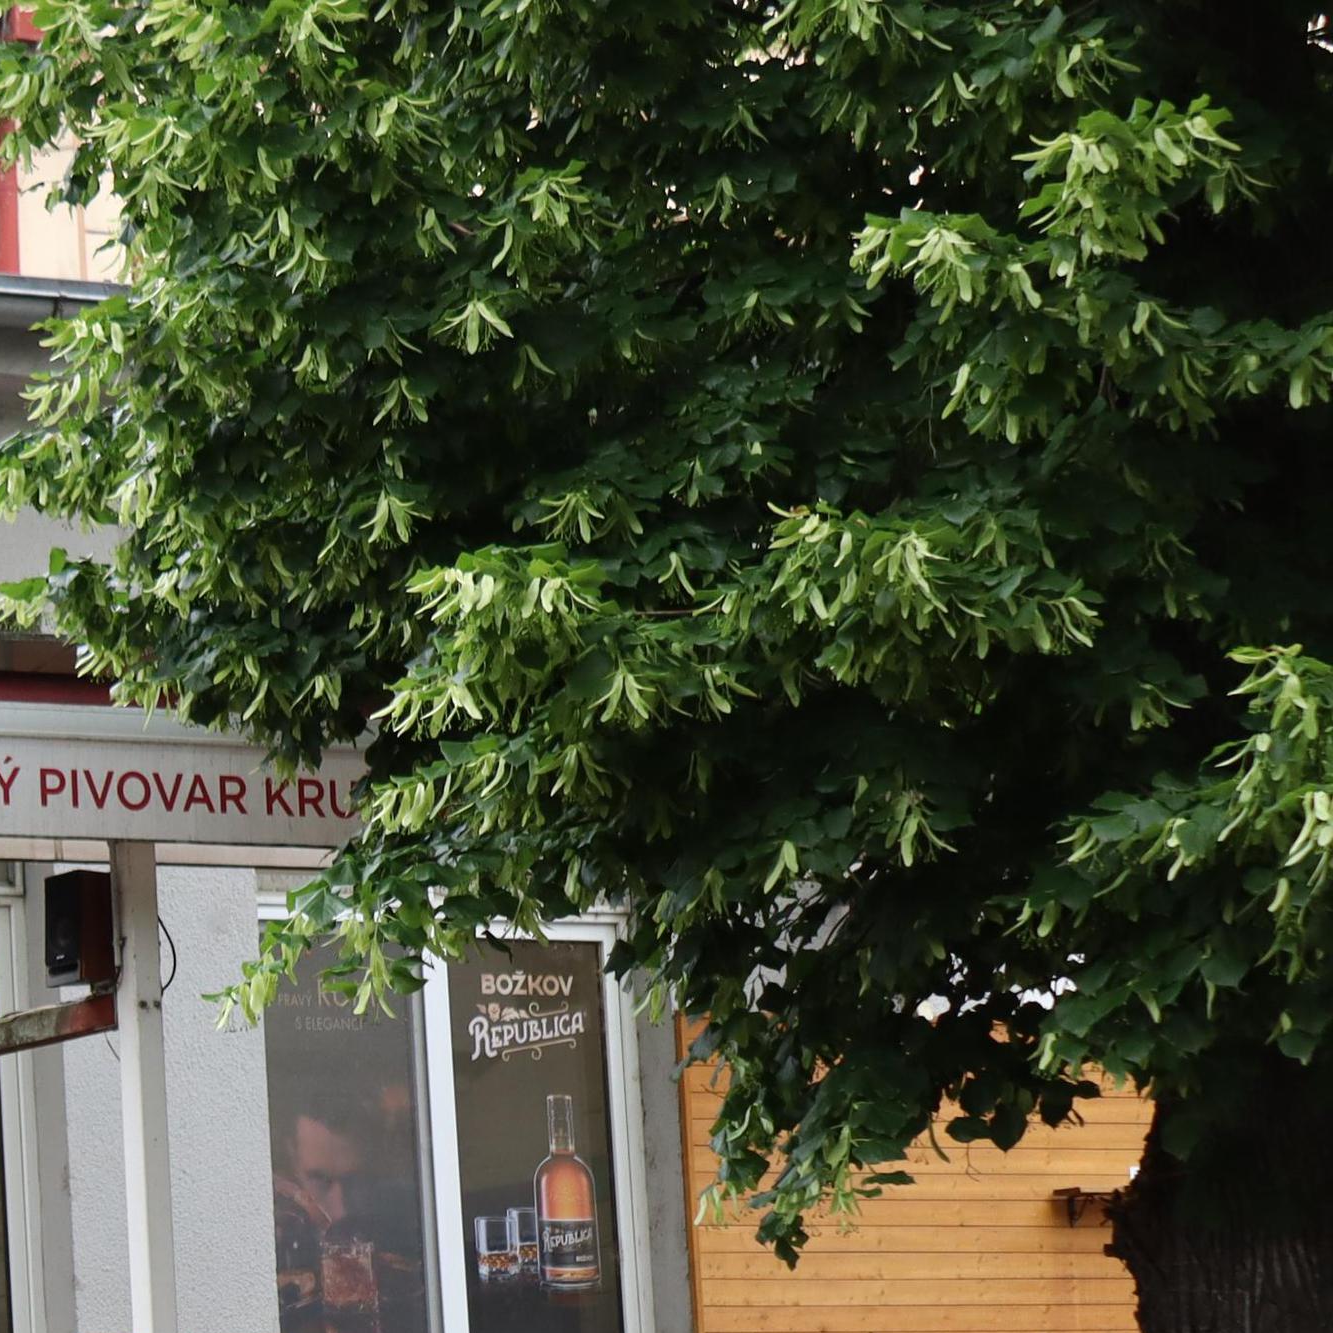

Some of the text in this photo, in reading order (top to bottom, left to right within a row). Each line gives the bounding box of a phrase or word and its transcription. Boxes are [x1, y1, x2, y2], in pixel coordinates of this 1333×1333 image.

[38, 766, 248, 814] PIVOVAR
[264, 776, 359, 819] KRU
[480, 970, 574, 997] BOŽKOV
